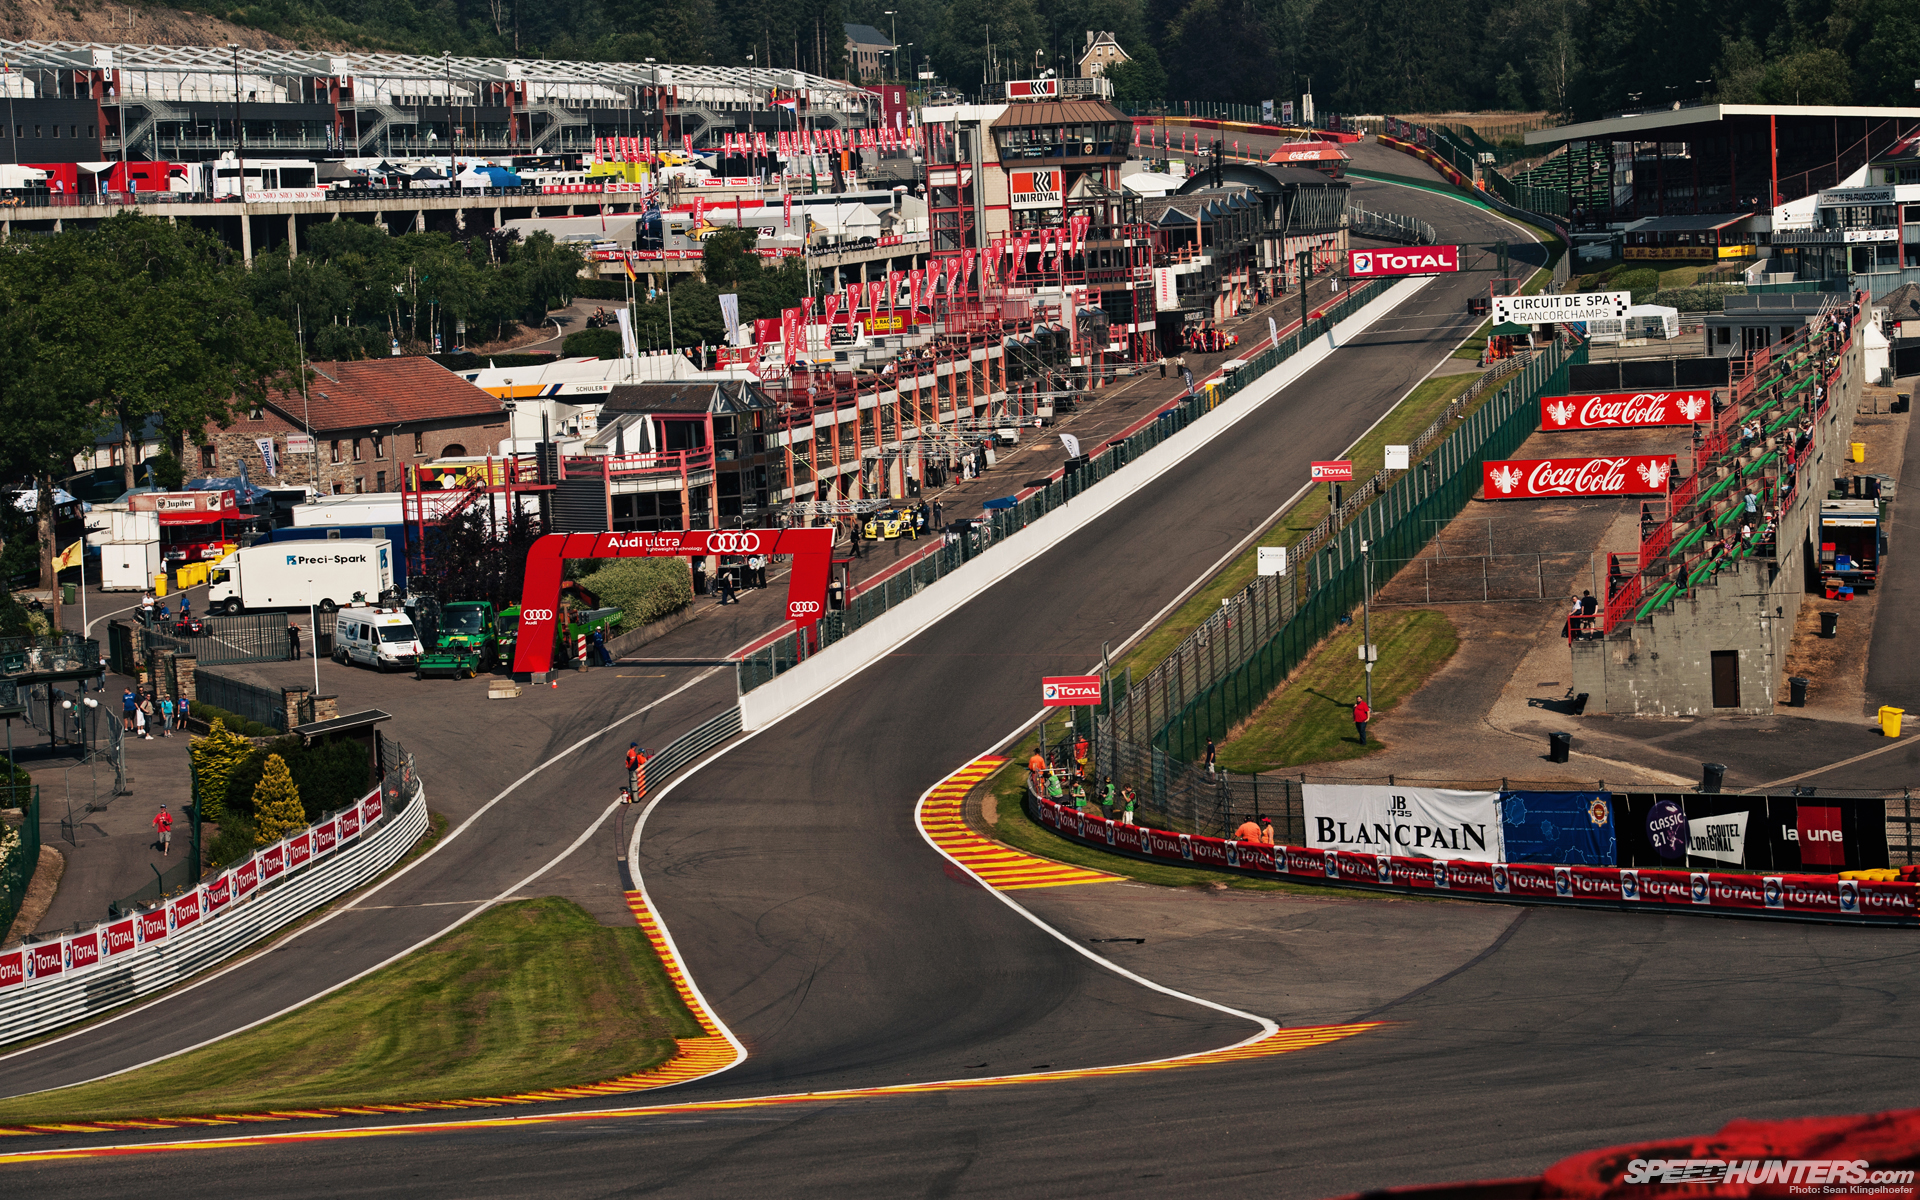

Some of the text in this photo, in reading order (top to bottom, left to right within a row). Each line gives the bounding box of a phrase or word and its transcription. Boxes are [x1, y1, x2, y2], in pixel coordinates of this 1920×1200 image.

[105, 66, 111, 80] 3
[341, 75, 346, 86] 4
[515, 78, 520, 90] 5
[247, 191, 261, 199] SRO
[263, 191, 277, 199] SRO
[279, 191, 292, 199] SRO
[311, 190, 324, 198] SRO
[1013, 192, 1060, 203] UNIROYAL
[1376, 253, 1452, 270] TOTAL
[1513, 295, 1610, 310] CIRCUIT DE SPA
[1513, 309, 1609, 322] FRANCORCHAMPS
[1580, 393, 1670, 426] Coca-Cola
[1322, 466, 1352, 476] TOTAL
[1527, 458, 1630, 495] Coca-Cola
[166, 499, 193, 510] Jupiler
[608, 536, 680, 548] Audi ultra
[165, 550, 185, 560] Jupiler
[203, 548, 222, 558] Jupiler
[298, 554, 367, 565] Preci-Spark
[1059, 686, 1100, 696] TOTAL
[365, 800, 381, 817] TOTAL
[1387, 809, 1412, 817] 1735
[342, 818, 359, 833] TOTAL
[1059, 811, 1078, 830] TOTAL
[1084, 819, 1106, 838] TOTAL
[1649, 812, 1684, 832] CLASSIC
[317, 831, 335, 846] TOTAL
[1114, 828, 1140, 846] TOTAL
[1315, 816, 1487, 852] BLANCPAIN
[1706, 823, 1740, 837] ECOUTEZ
[1782, 824, 1843, 843] la une
[291, 844, 309, 859] TOTAL
[1150, 836, 1181, 853] TOTAL
[1191, 843, 1226, 859] TOTAL
[265, 856, 283, 872] TOTAL
[1238, 848, 1274, 865] TOTAL
[1287, 852, 1324, 871] TOTAL
[1338, 857, 1376, 877] TOTAL
[1392, 863, 1433, 881] TOTAL
[238, 870, 257, 888] TOTAL
[1450, 868, 1492, 885] TOTAL
[1510, 871, 1554, 889] TOTAL
[1572, 875, 1619, 893] TOTAL
[1639, 876, 1689, 896] TOTAL
[1711, 881, 1761, 900] TOTAL
[1784, 885, 1837, 904] TOTAL
[208, 886, 230, 905] TOTAL
[1860, 888, 1915, 908] TOTAL
[176, 903, 199, 920] TOTAL
[144, 919, 166, 935] TOTAL
[109, 931, 134, 947] TOTAL
[73, 943, 97, 960] TOTAL
[36, 953, 62, 970] TOTAL
